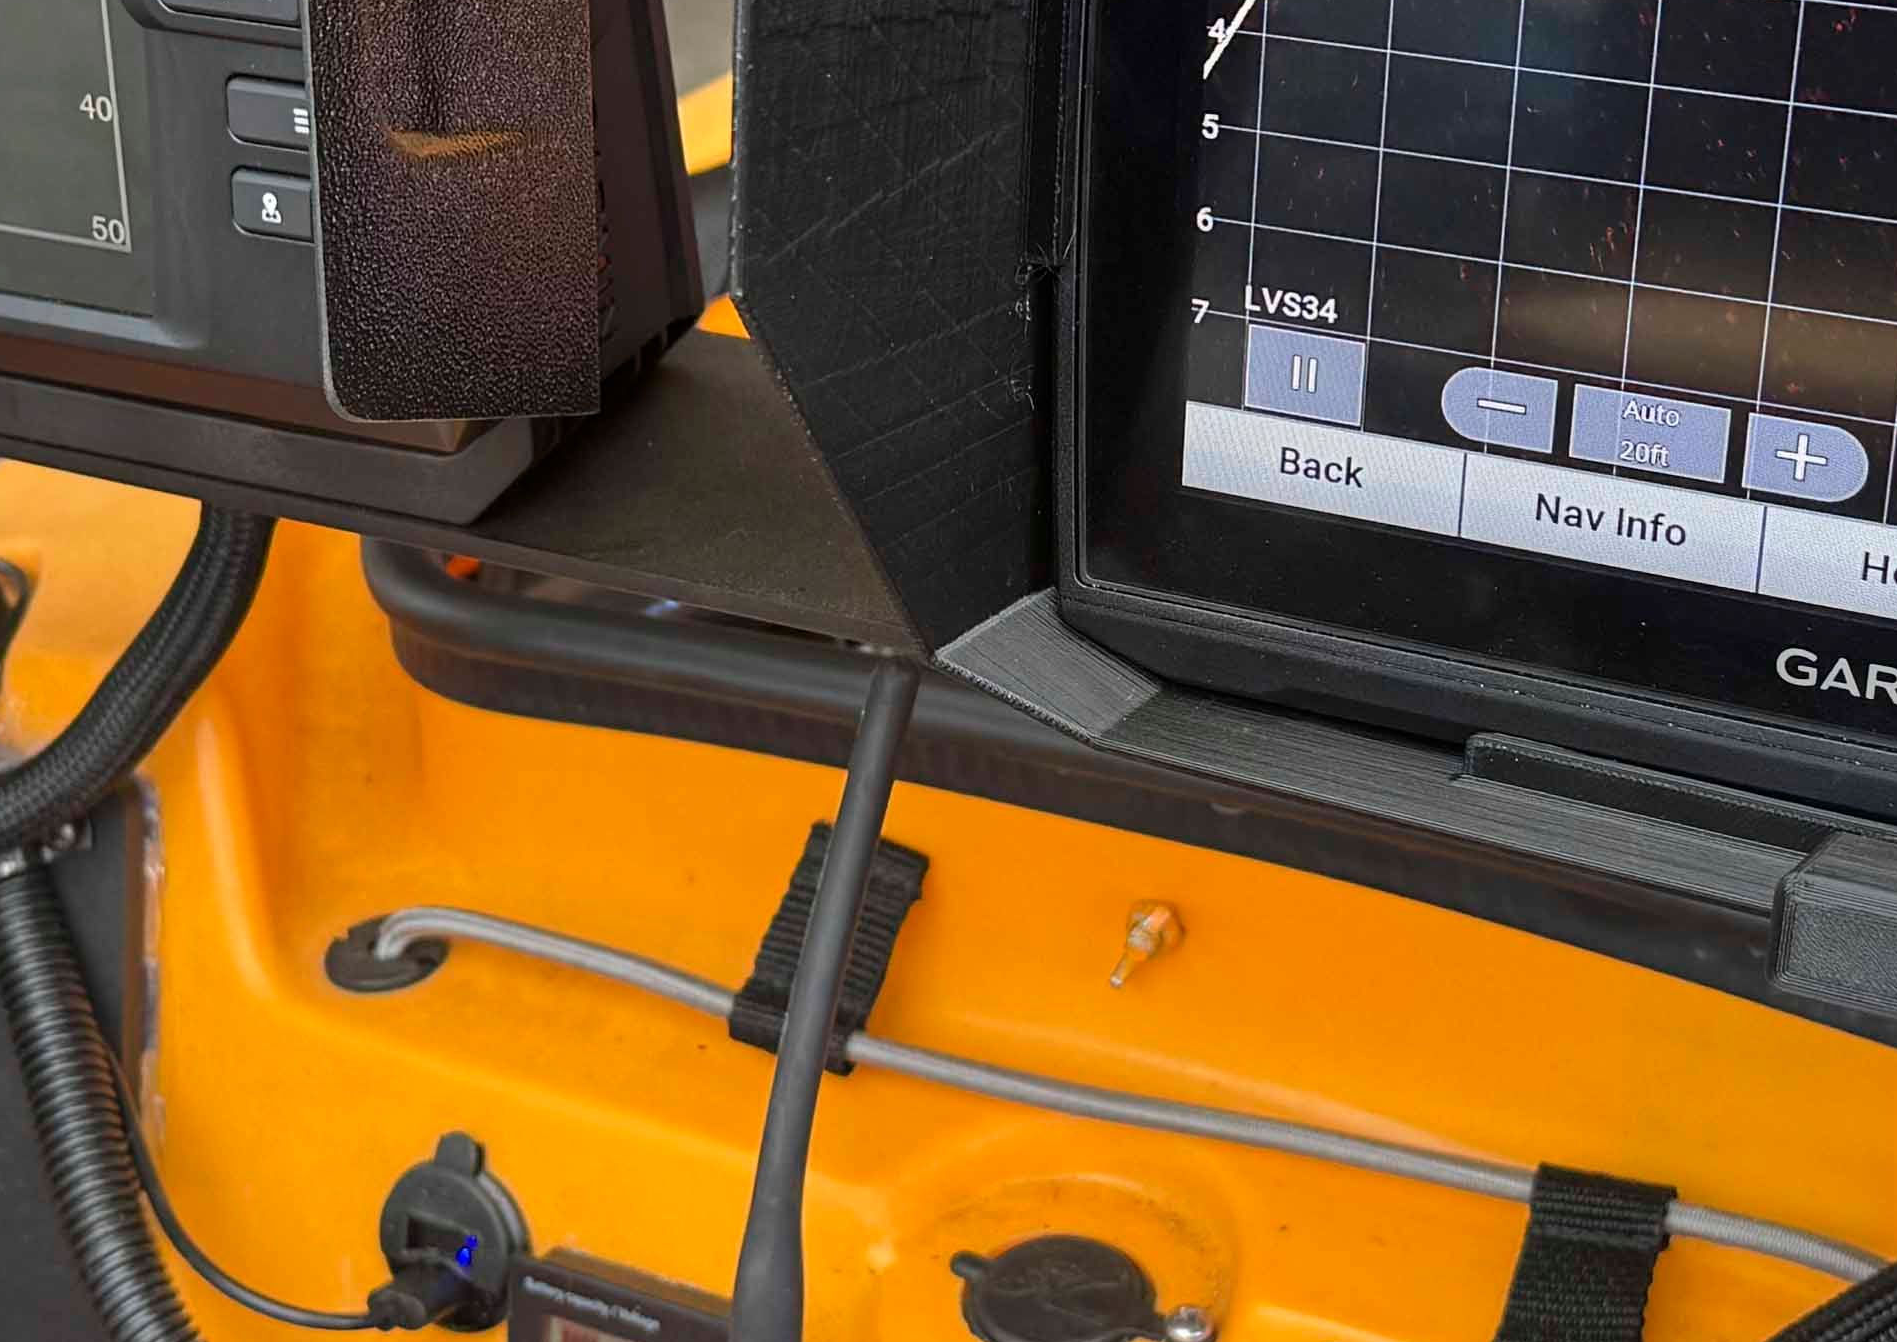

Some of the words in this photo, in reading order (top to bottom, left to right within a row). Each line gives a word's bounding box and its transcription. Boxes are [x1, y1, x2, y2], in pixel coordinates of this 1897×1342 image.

[1208, 18, 1228, 41] 4
[80, 95, 113, 122] 40
[1202, 114, 1219, 139] 5
[91, 216, 125, 244] 50
[1197, 207, 1214, 232] 6
[1192, 300, 1210, 324] 7
[1244, 284, 1338, 324] LVS34
[1622, 398, 1680, 428] Auto
[1279, 446, 1364, 488] Back
[1619, 439, 1670, 469] 20ft
[1534, 494, 1604, 531] Nav
[1615, 506, 1687, 547] Info
